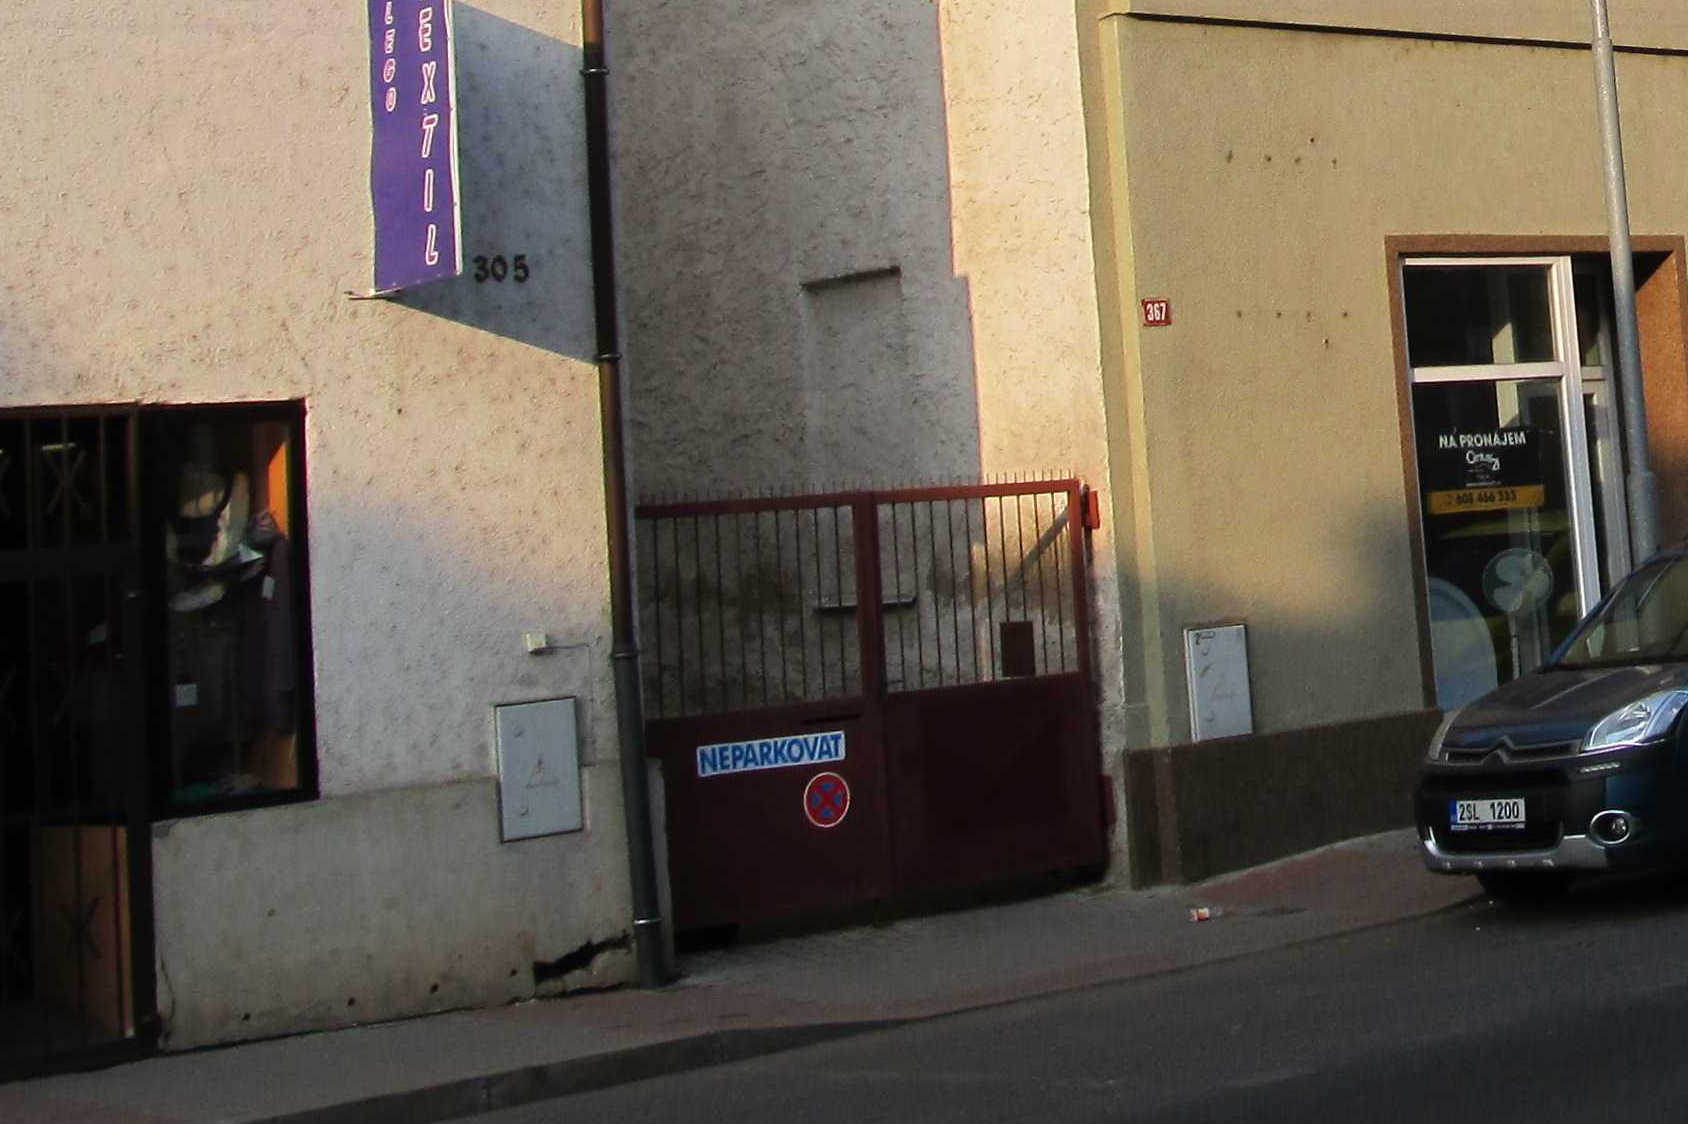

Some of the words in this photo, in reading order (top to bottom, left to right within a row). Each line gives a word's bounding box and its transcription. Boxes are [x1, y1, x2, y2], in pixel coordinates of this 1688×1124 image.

[473, 254, 529, 284] 305
[1146, 302, 1166, 321] 367
[1439, 434, 1458, 449] NA
[700, 733, 842, 774] NEPARKOVAT
[1459, 803, 1480, 821] 2SL
[1490, 801, 1520, 820] 1200
